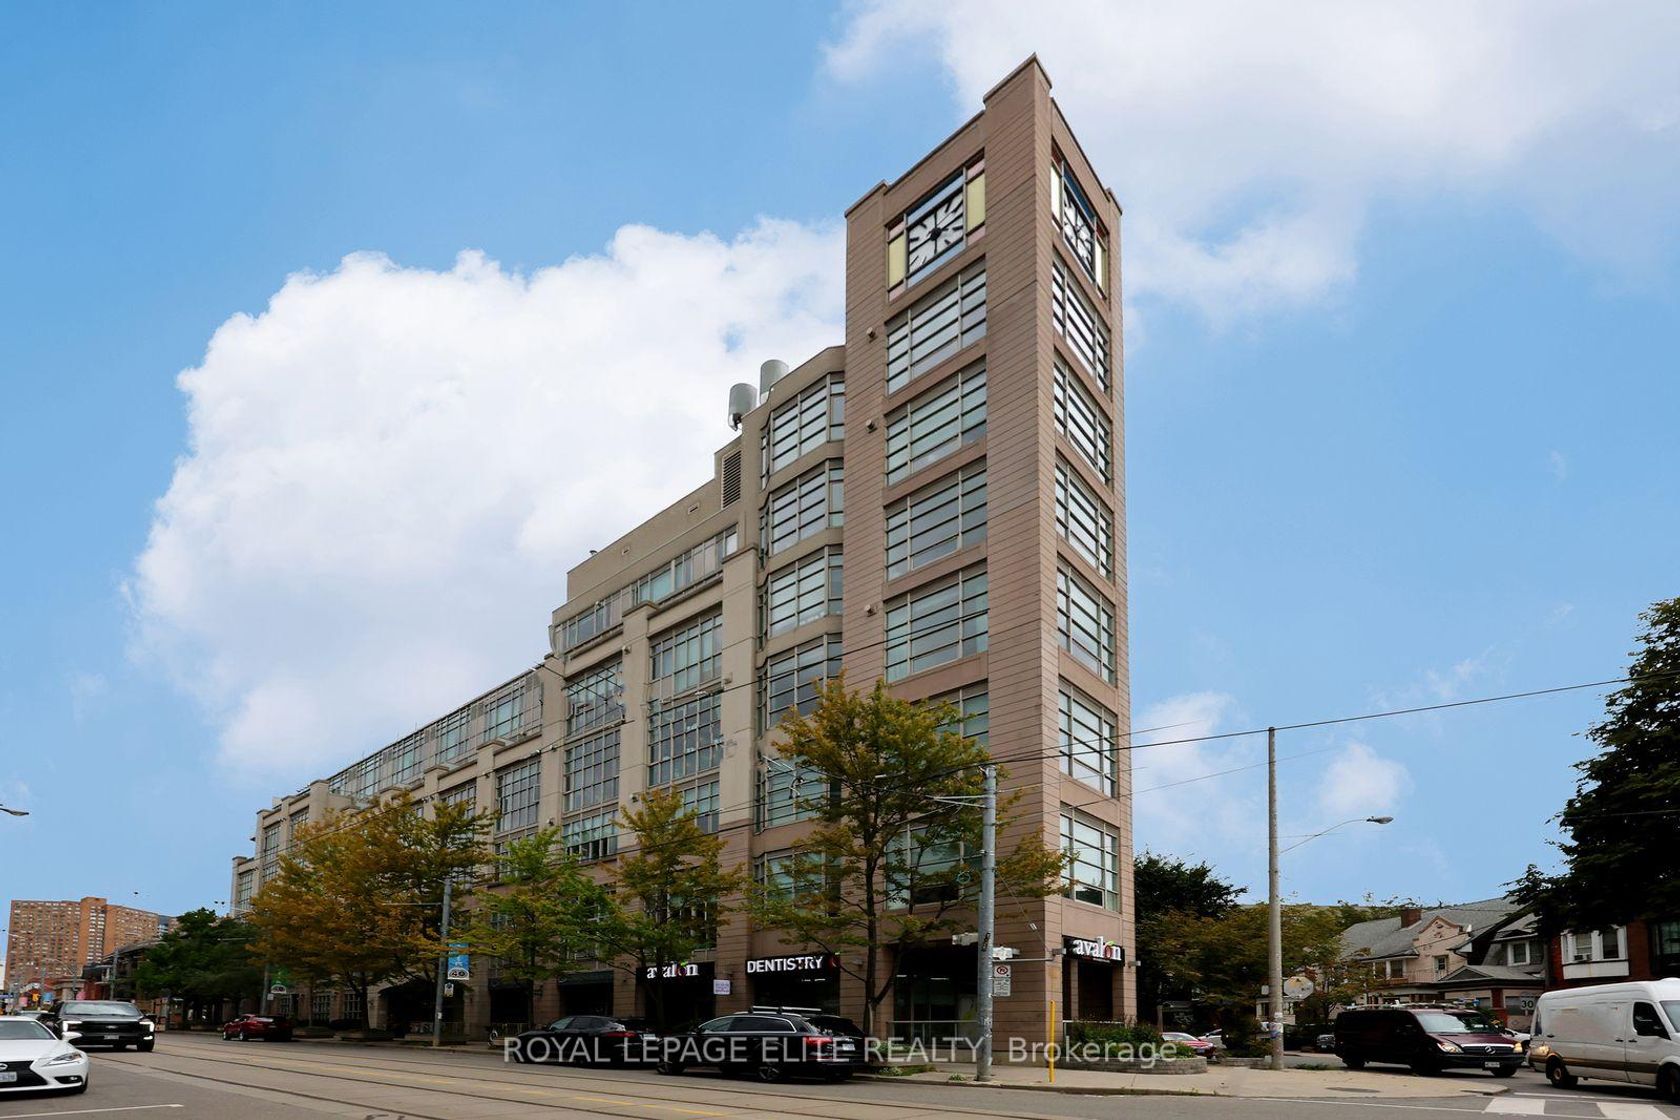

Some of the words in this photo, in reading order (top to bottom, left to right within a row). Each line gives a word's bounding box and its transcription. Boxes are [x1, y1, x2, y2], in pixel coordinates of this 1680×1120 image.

[1072, 936, 1122, 961] avalon
[747, 956, 823, 974] DENTISTRY
[1521, 1000, 1534, 1008] 30
